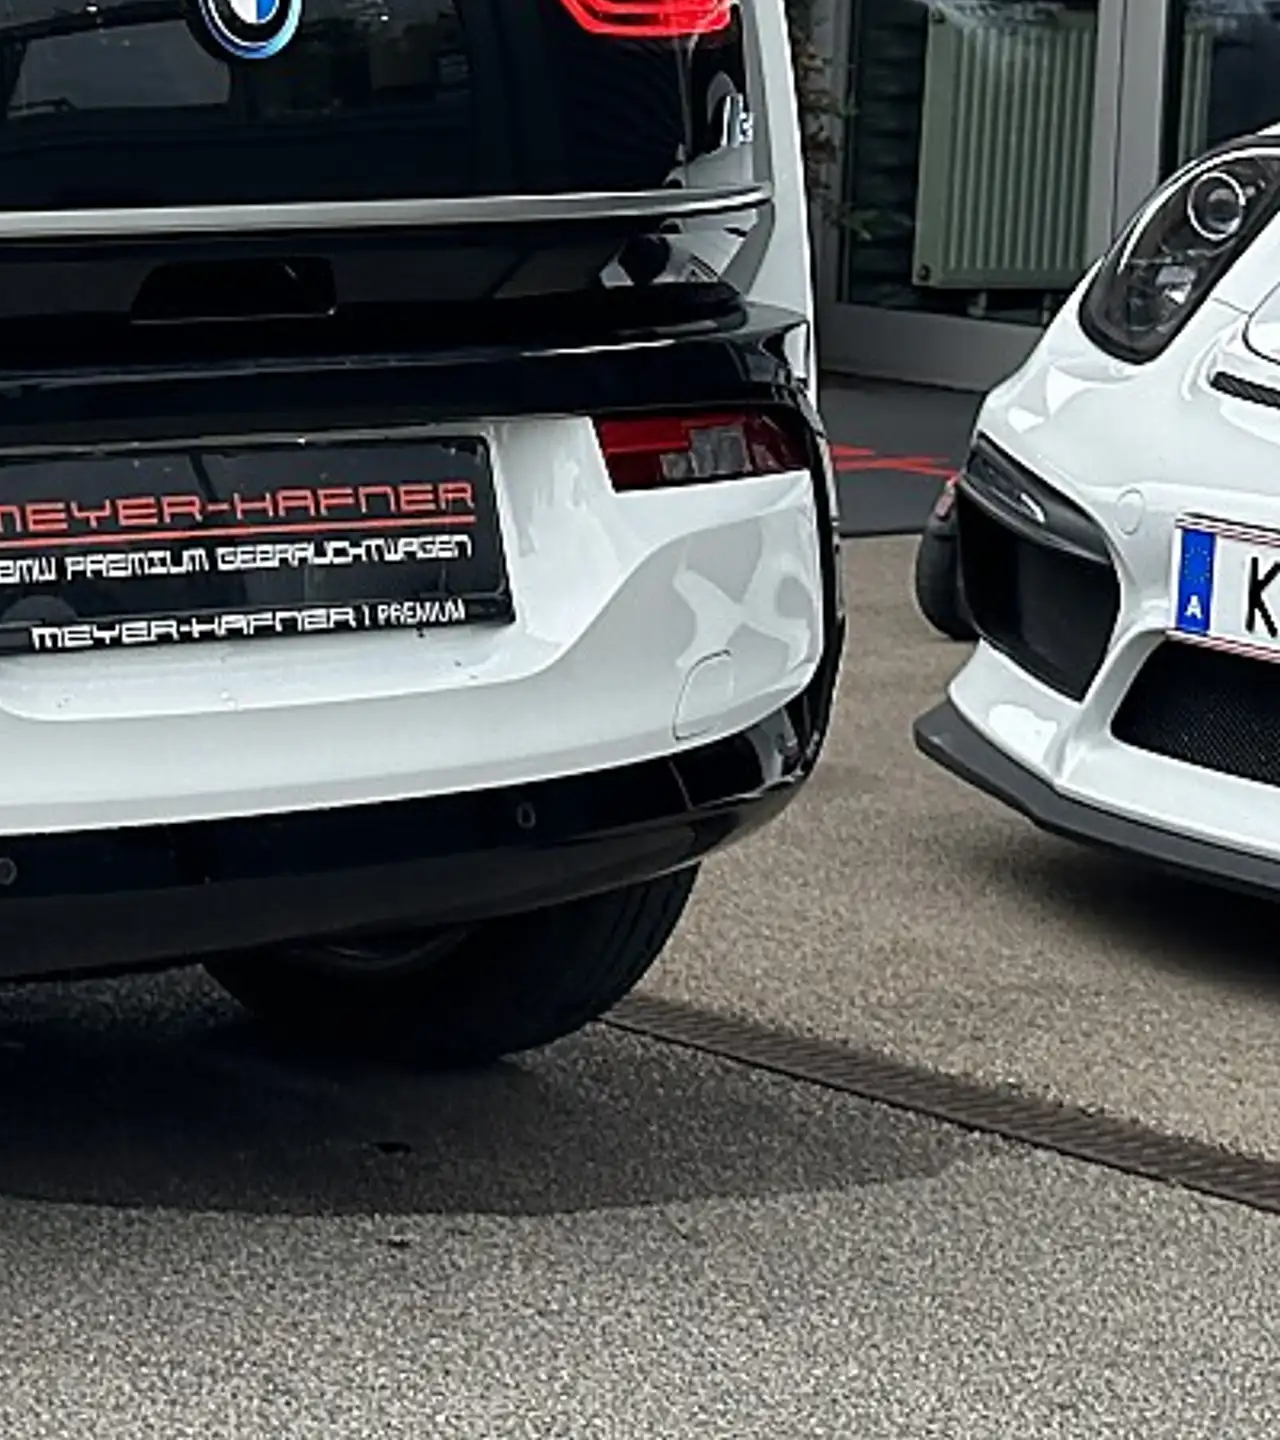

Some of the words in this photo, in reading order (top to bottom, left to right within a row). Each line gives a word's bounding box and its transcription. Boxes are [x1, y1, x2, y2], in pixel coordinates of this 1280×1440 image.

[65, 546, 210, 581] PREMIUM
[216, 533, 472, 571] GEBRAUCHTWAGEN
[31, 606, 356, 650] MEYER-HAFNER
[376, 597, 466, 625] PREMIUM
[1184, 595, 1203, 620] A
